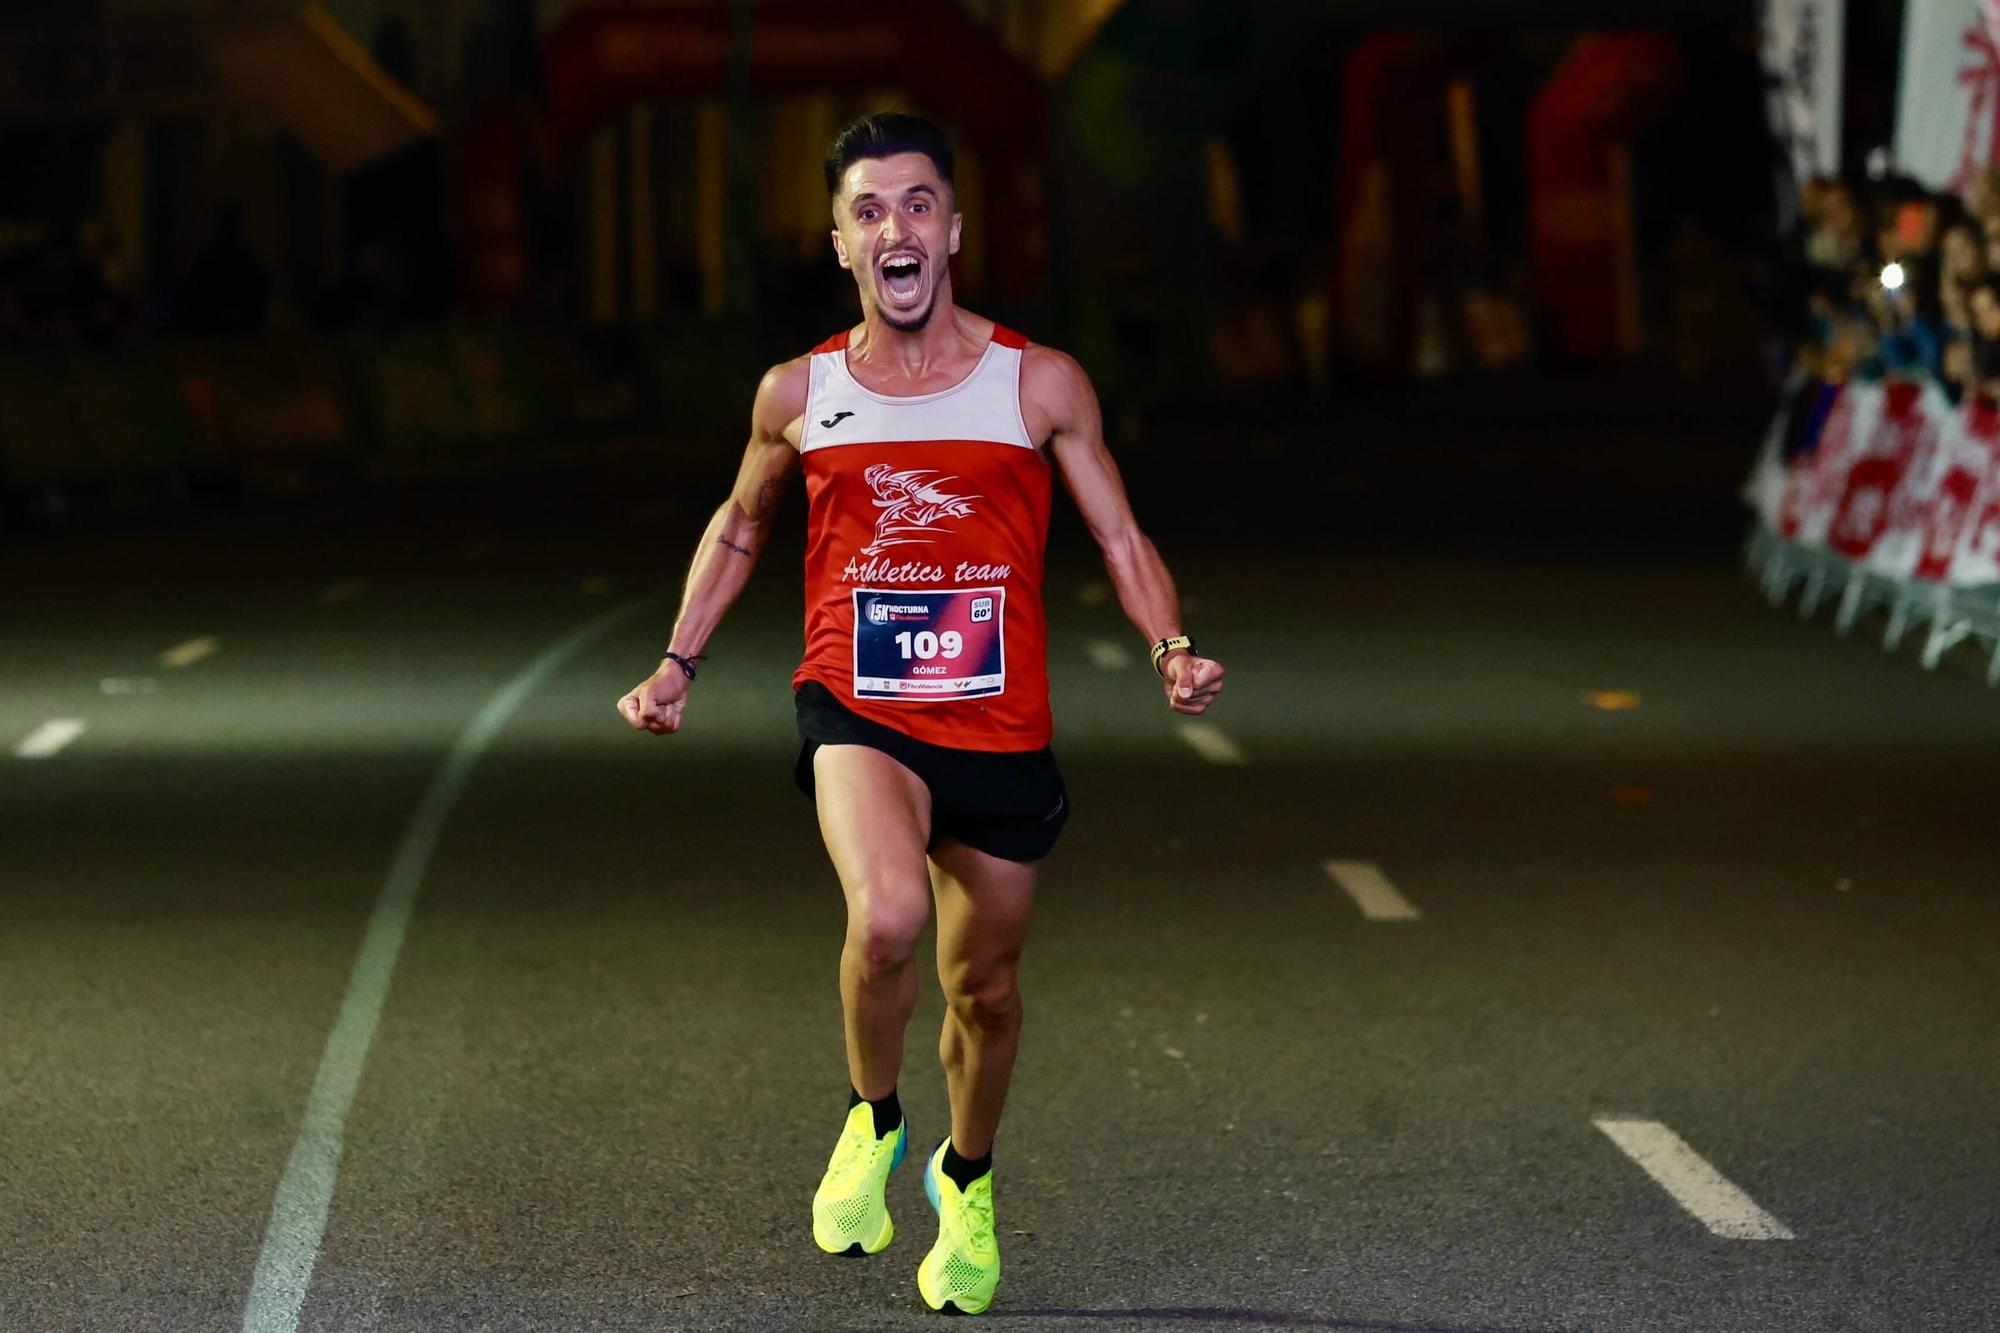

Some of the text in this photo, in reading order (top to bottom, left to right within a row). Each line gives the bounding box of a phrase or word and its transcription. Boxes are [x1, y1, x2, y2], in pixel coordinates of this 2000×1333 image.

[842, 555, 1011, 583] Athletics team
[974, 599, 990, 608] SUB
[889, 604, 929, 614] NOCTURNA
[895, 630, 963, 659] 109
[912, 665, 947, 675] GÓMEZ
